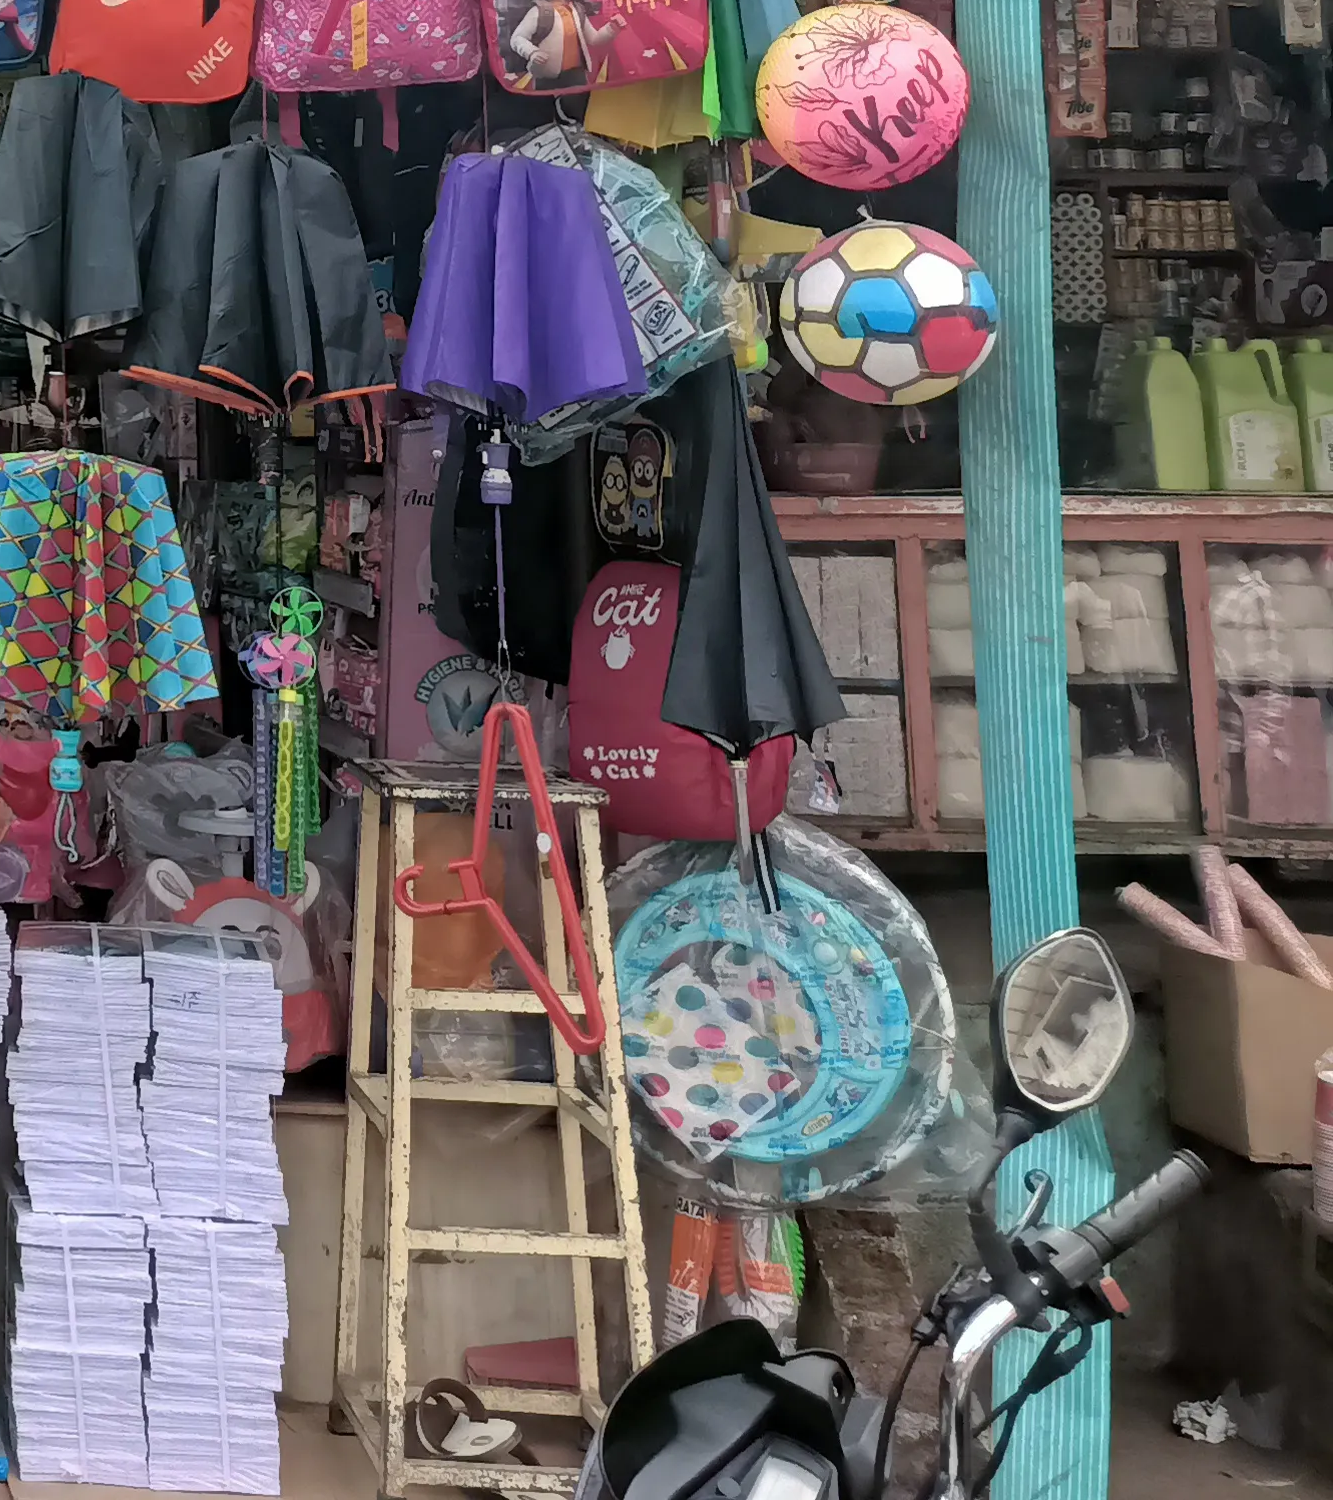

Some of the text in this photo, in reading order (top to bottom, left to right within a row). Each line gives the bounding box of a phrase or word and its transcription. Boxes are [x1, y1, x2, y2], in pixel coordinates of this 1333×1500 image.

[185, 36, 234, 86] NIKE
[842, 47, 950, 164] Keep
[592, 587, 662, 627] Cat
[415, 656, 473, 703] HYGIENE
[598, 746, 660, 762] Lovely
[606, 764, 640, 780] Cat
